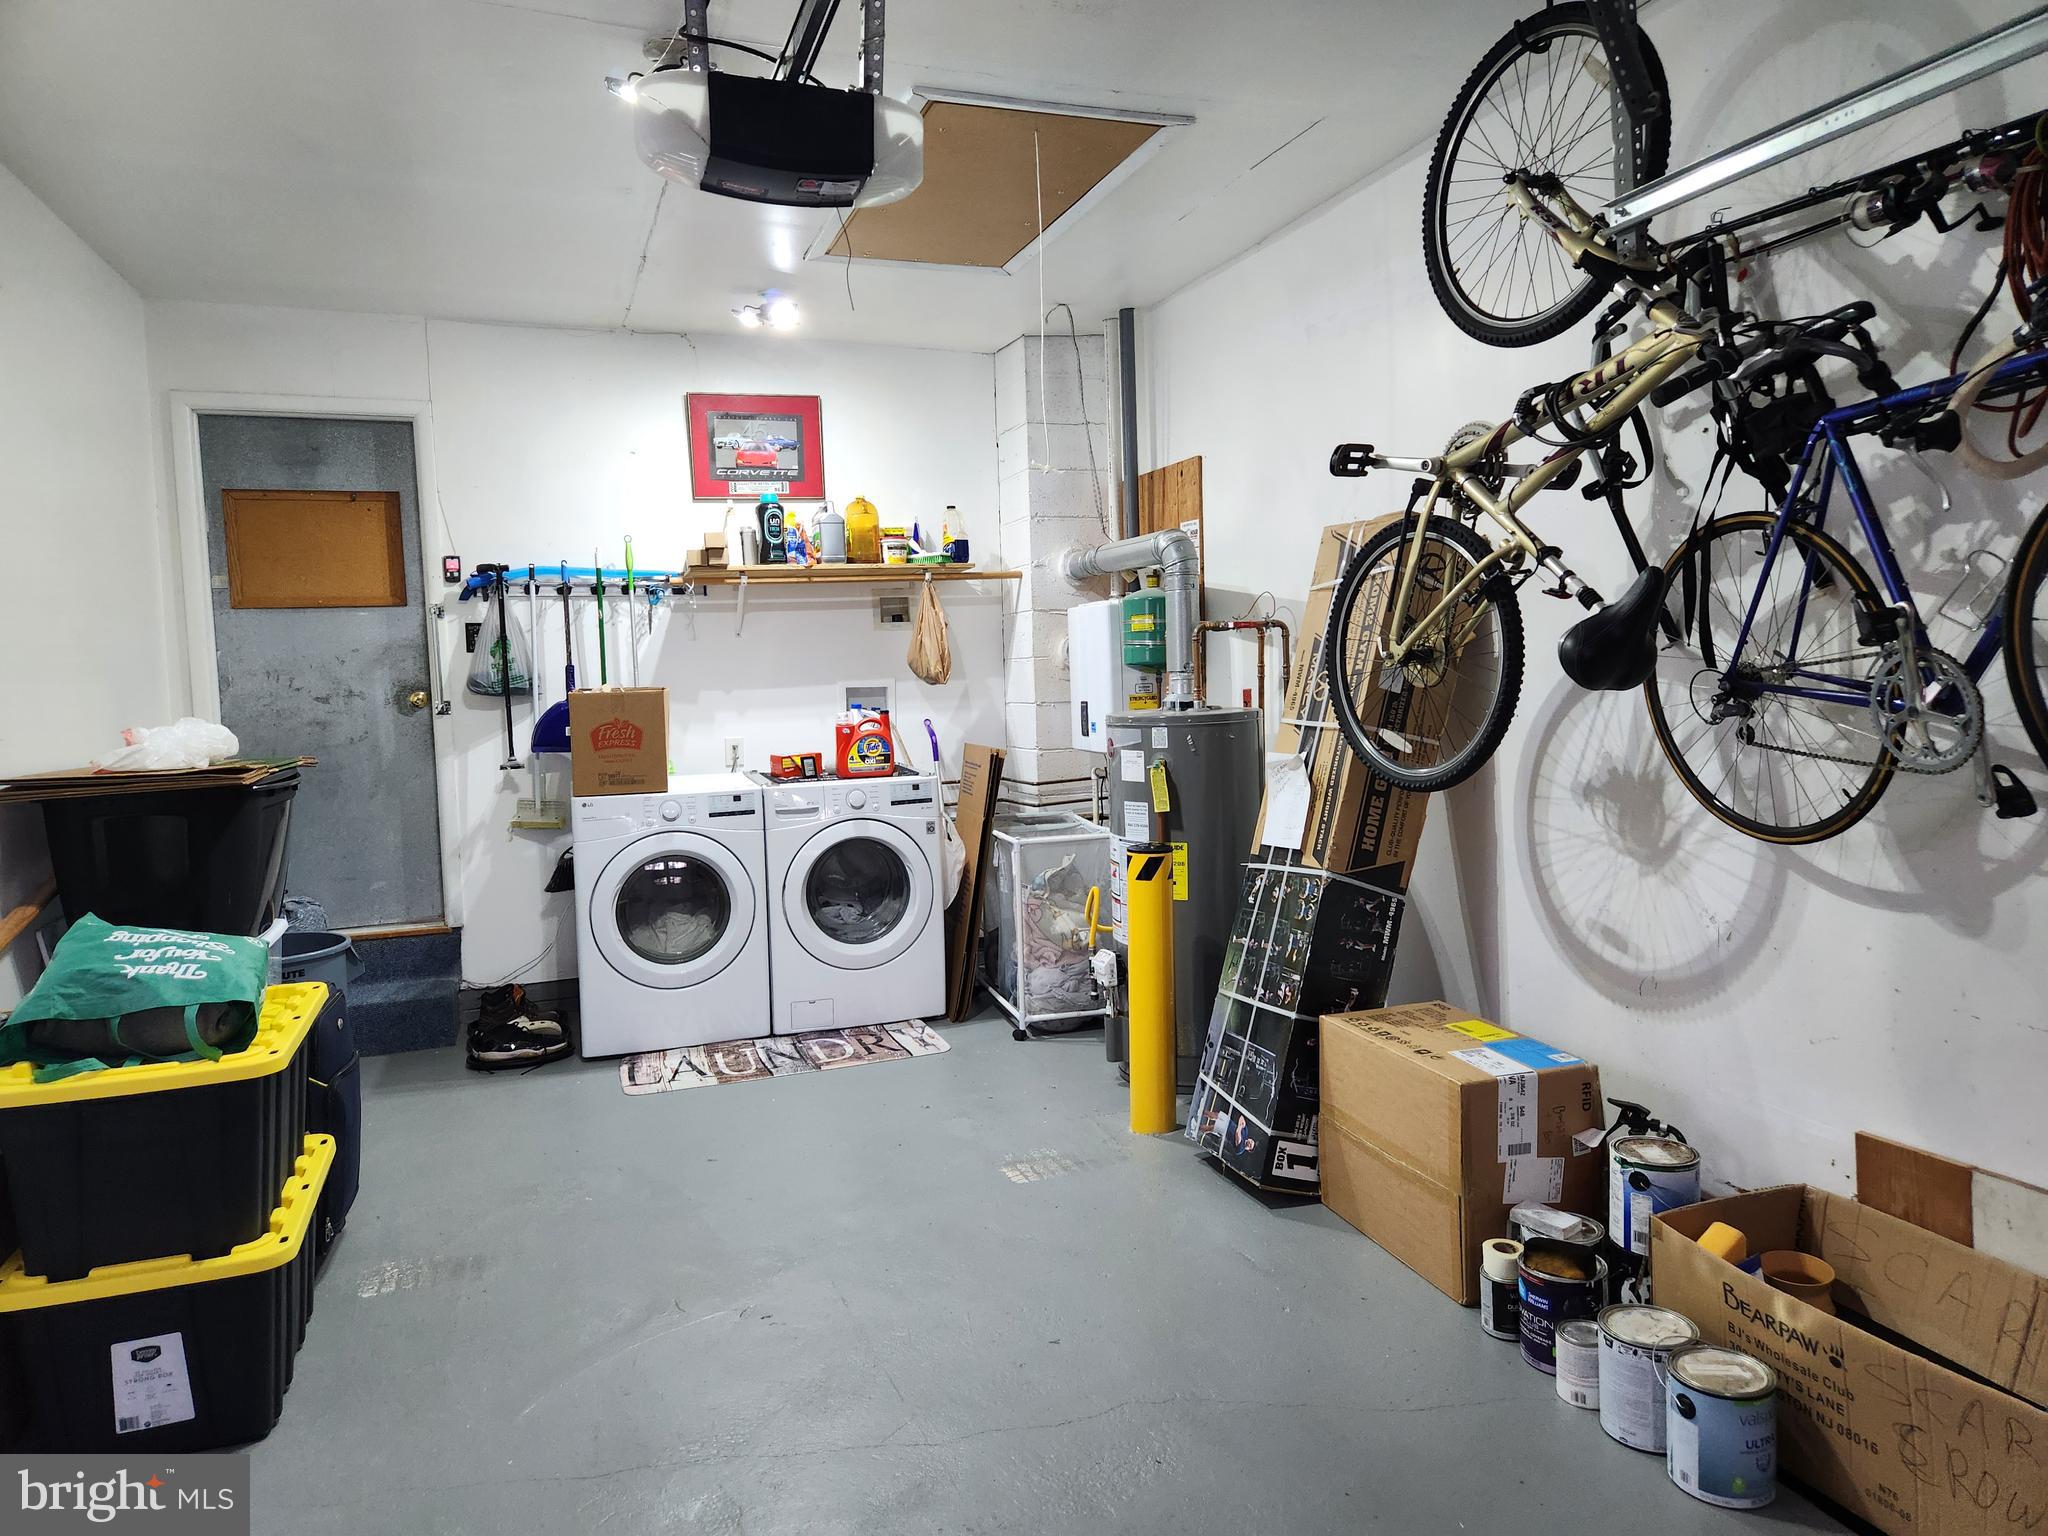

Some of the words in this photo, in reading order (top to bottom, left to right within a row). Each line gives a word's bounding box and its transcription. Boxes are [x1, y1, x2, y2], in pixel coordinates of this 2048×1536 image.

[716, 468, 798, 476] CORVETTE
[598, 739, 635, 748] EXPRESS
[599, 725, 635, 740] Fresh
[866, 743, 880, 752] Tide
[1323, 785, 1335, 817] WEIGHT
[1316, 817, 1327, 851] STACK
[1361, 794, 1385, 852] HOME
[1383, 897, 1397, 945] MWM-4965
[104, 931, 235, 953] Shopping
[114, 946, 171, 962] for
[167, 948, 221, 961] You
[113, 964, 207, 979] Thank
[627, 1024, 941, 1087] LAUNDRY
[1582, 1082, 1591, 1112] RFID
[1274, 1146, 1287, 1171] BOX
[1287, 1153, 1317, 1170] 1
[1528, 1292, 1548, 1305] SHERWIN
[1528, 1298, 1548, 1310] WILLIAMS
[1519, 1304, 1554, 1330] VATION
[1722, 1281, 1819, 1356] BEARPAW
[1728, 1321, 1751, 1343] BJ's
[1753, 1336, 1819, 1382] Wholesale
[1823, 1376, 1855, 1401] Club
[1807, 1387, 1846, 1416] LANE
[1815, 1410, 1834, 1430] NJ
[1836, 1421, 1880, 1456] 08016
